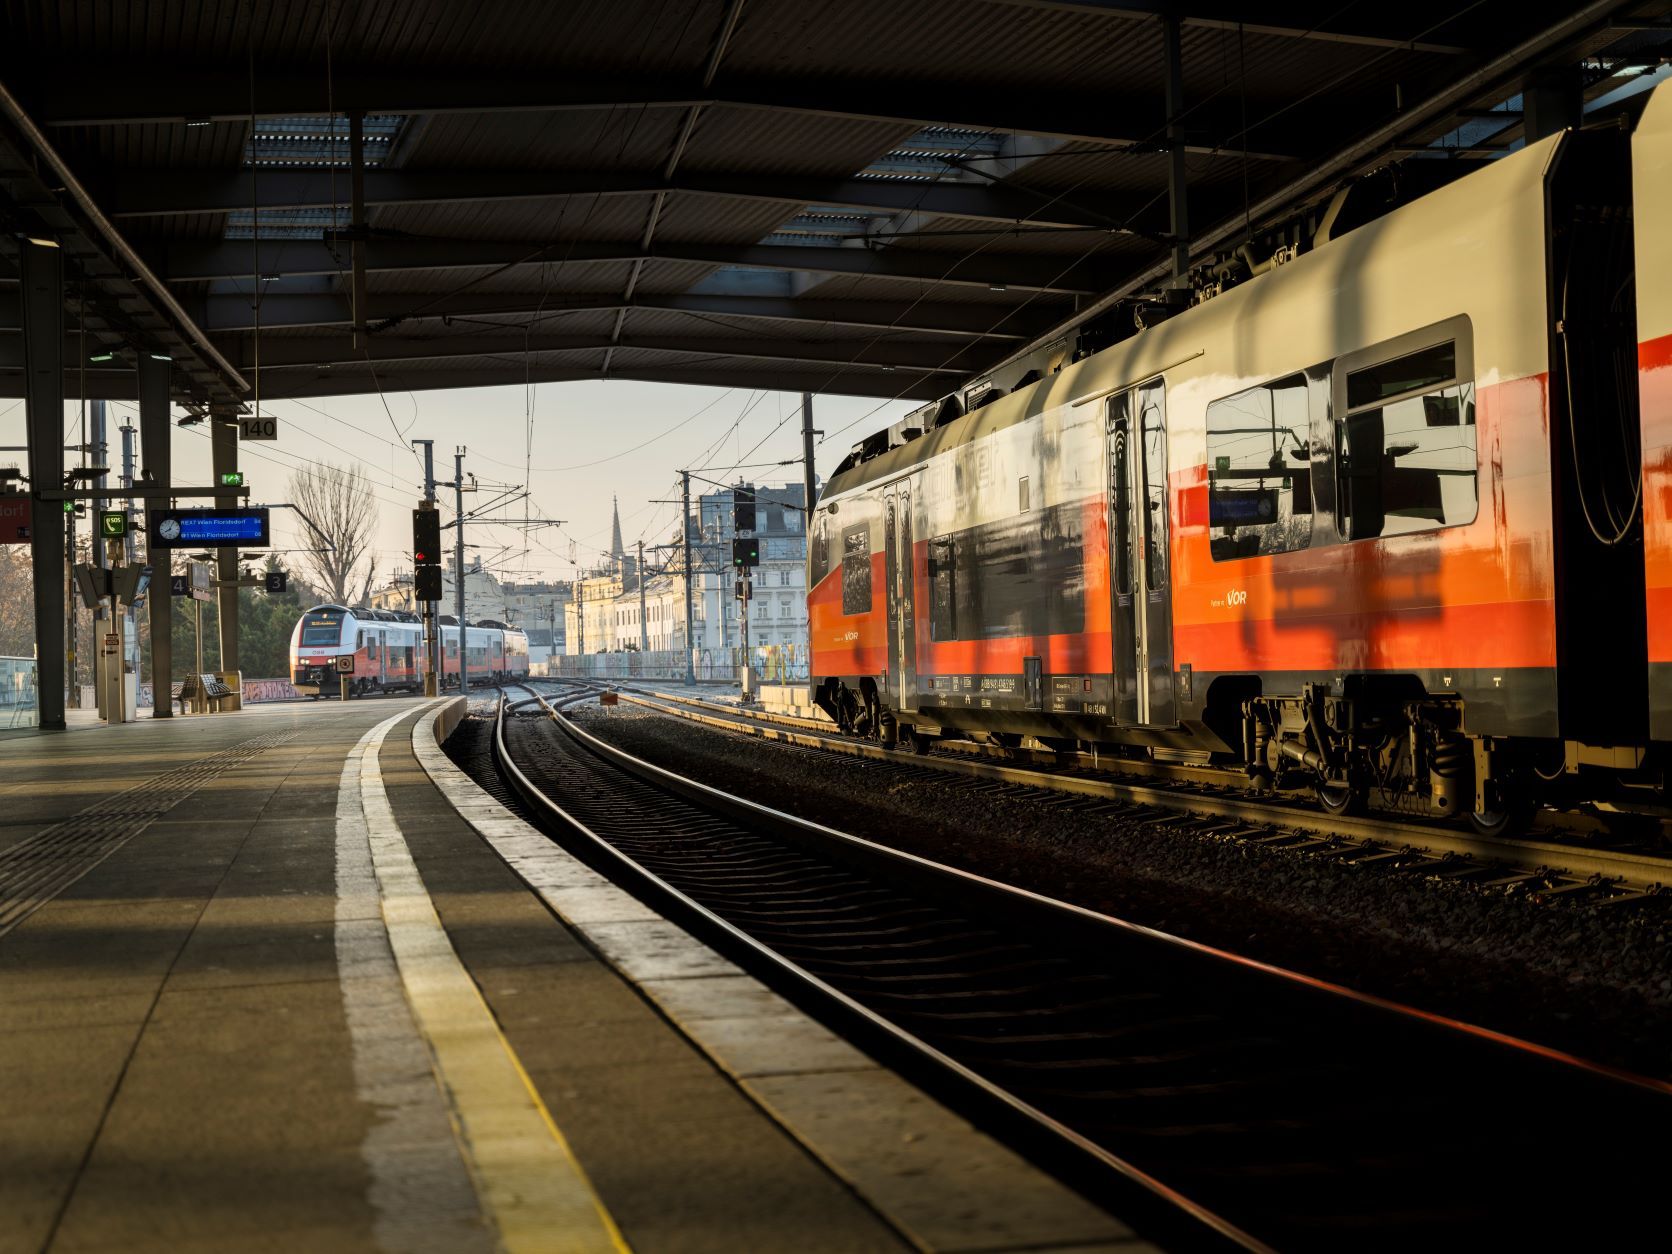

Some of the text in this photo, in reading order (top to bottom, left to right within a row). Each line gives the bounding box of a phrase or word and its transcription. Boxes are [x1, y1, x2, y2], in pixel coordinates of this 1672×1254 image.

[241, 421, 275, 436] 140
[174, 579, 184, 592] 4
[272, 576, 281, 589] 3
[1227, 588, 1247, 607] VOR
[845, 631, 859, 641] VOR
